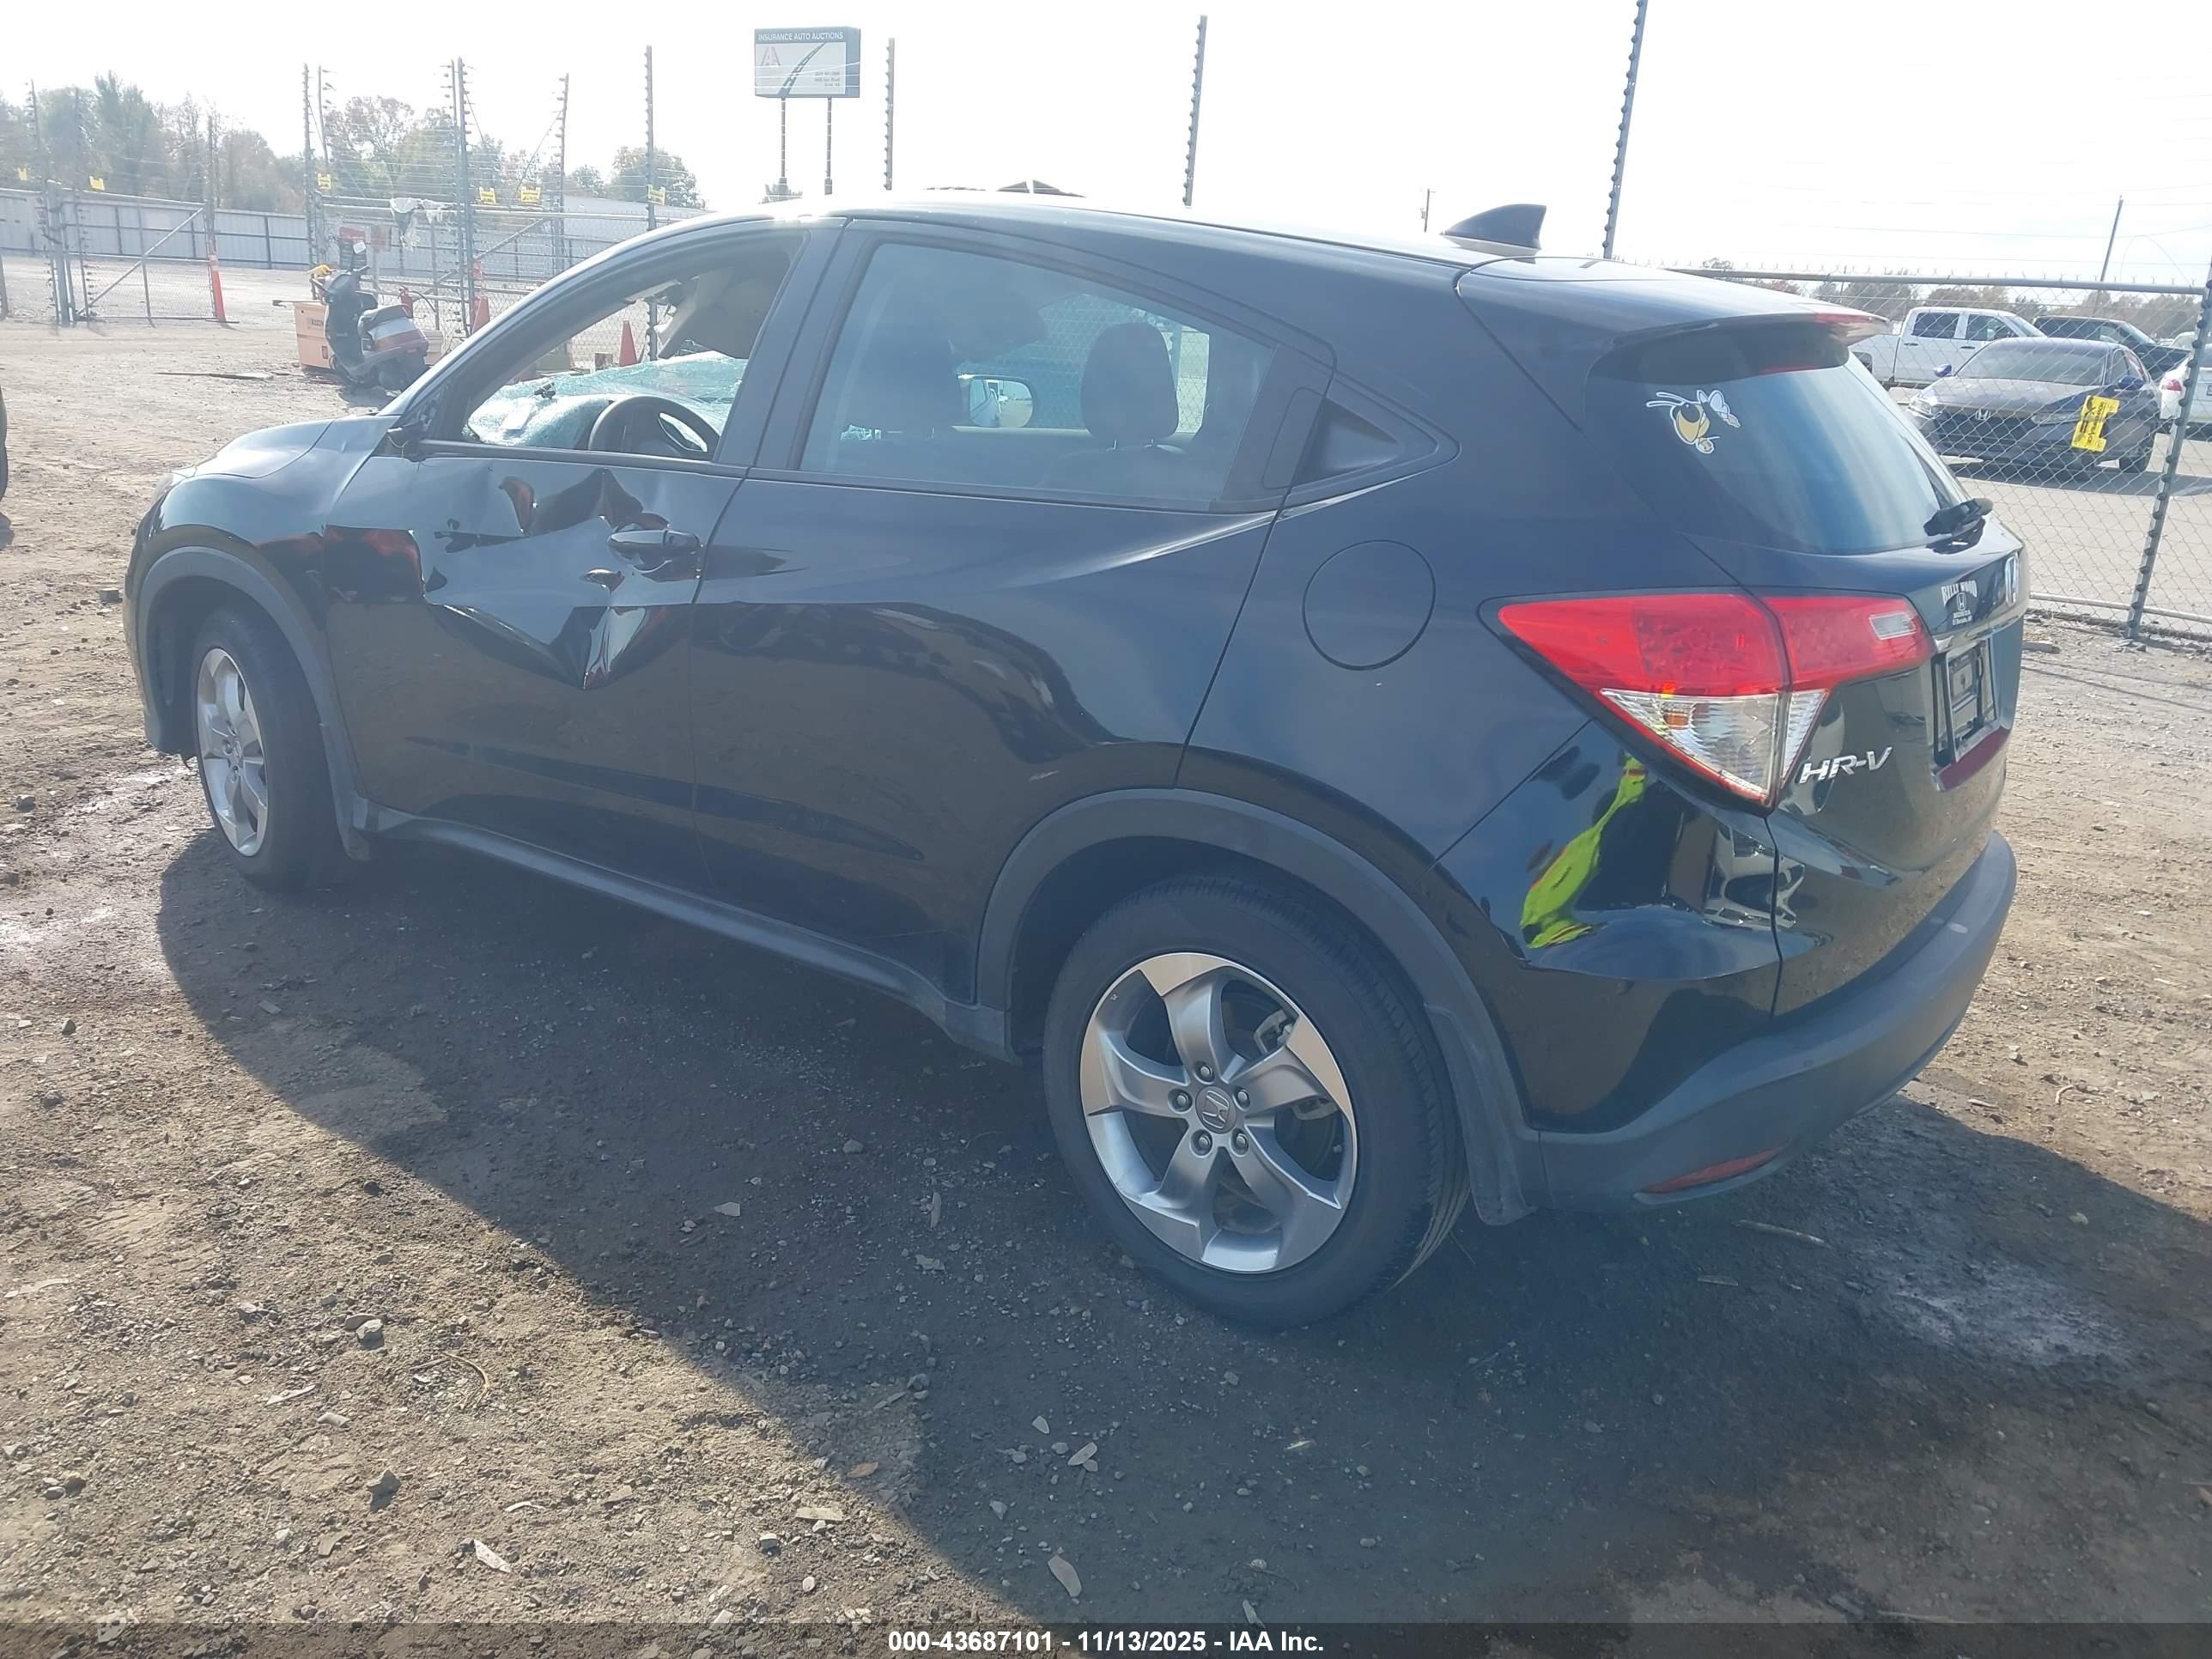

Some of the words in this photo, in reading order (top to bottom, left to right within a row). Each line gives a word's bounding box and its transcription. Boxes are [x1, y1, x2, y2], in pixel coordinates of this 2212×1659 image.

[757, 33, 793, 41] INSURANCE
[793, 32, 811, 40] AUTO
[811, 31, 844, 40] AUCTIONS
[1799, 746, 1893, 783] HR-V
